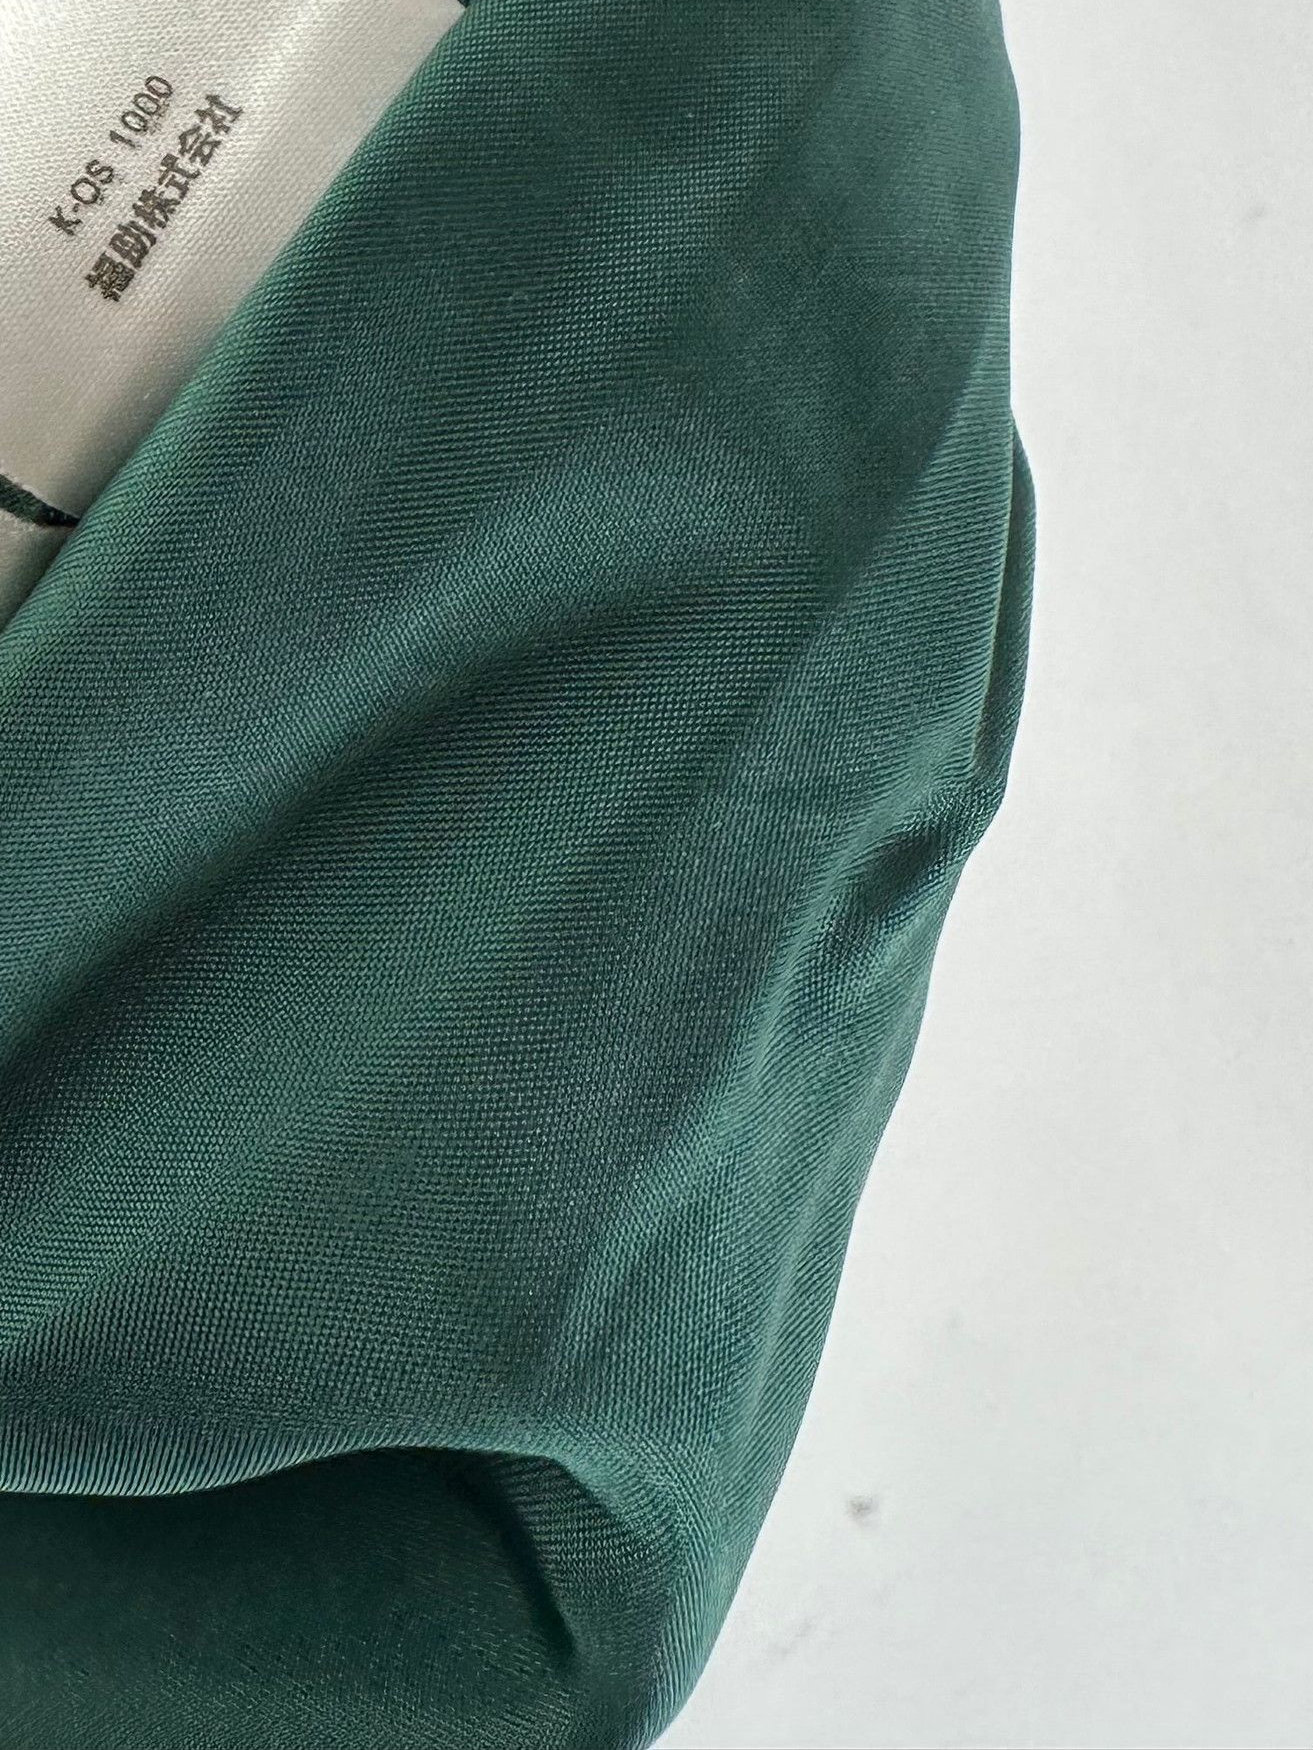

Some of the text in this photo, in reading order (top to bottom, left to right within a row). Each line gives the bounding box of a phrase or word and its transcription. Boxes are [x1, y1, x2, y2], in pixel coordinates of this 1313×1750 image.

[48, 75, 174, 236] K-OS 1000
[85, 94, 244, 302] 福助株式会社
